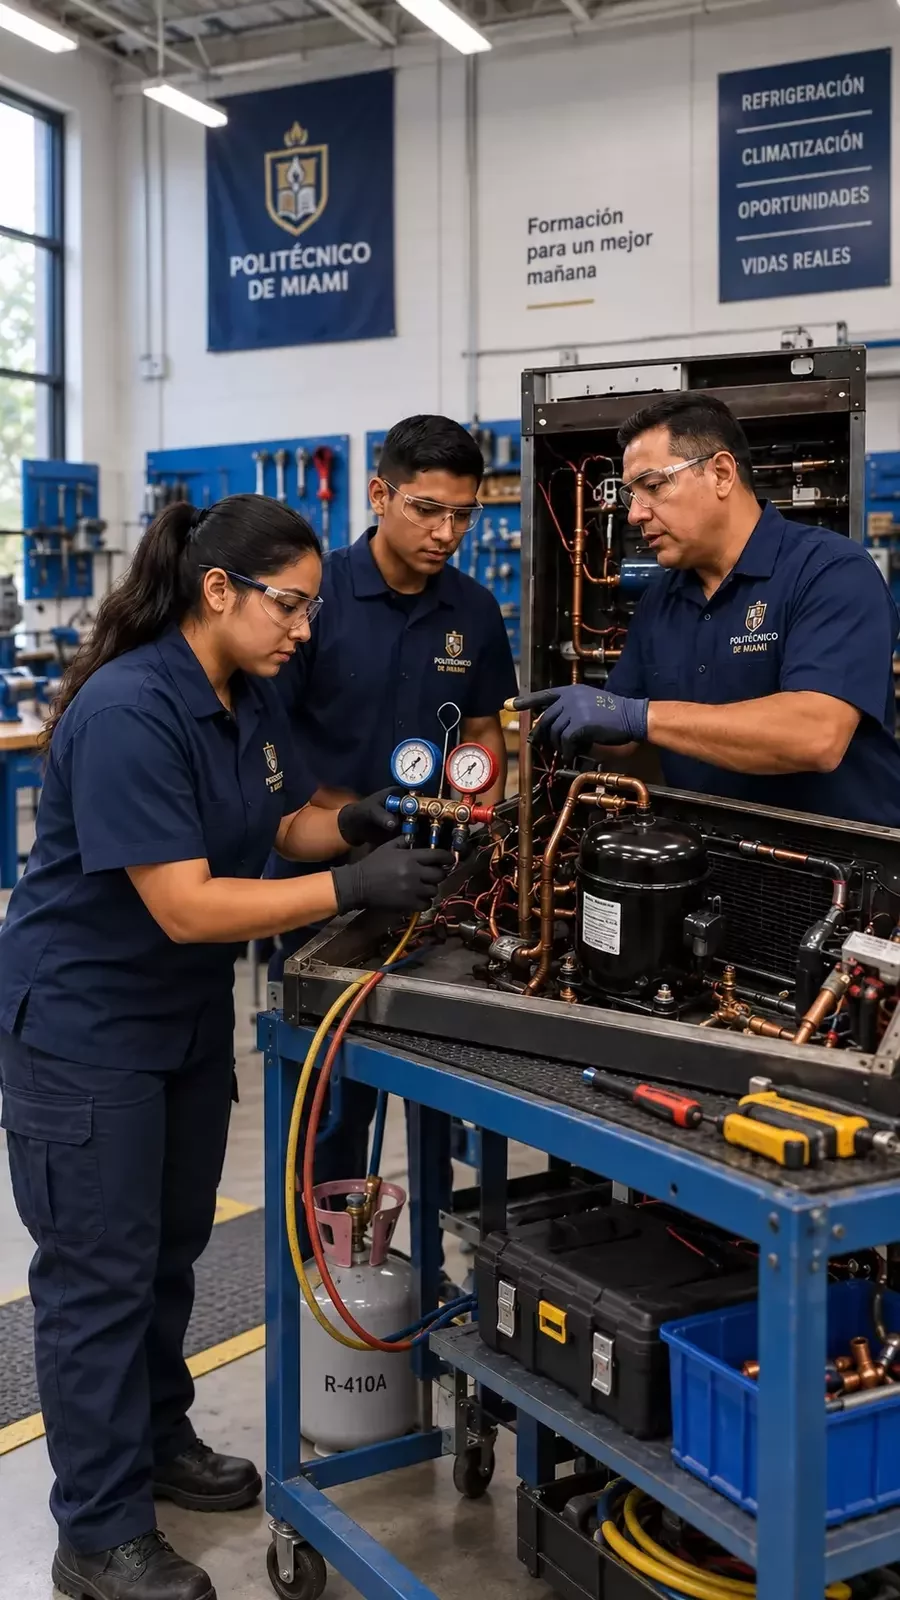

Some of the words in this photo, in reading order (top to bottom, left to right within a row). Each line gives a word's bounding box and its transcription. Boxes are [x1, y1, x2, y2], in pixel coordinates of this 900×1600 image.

[742, 73, 865, 112] REFRIGERACIÓN
[742, 129, 864, 166] CLIMATIZACIÓN
[738, 185, 870, 220] OPORTUNIDADES
[527, 207, 624, 235] Formación
[230, 242, 371, 277] POLITÉCNICO
[527, 242, 566, 265] para
[572, 239, 595, 255] un
[600, 230, 653, 253] mejor
[742, 253, 788, 275] VIDAS
[793, 246, 851, 271] REALES
[248, 278, 275, 301] DE
[281, 270, 348, 297] MIAMI
[527, 264, 597, 285] mañana
[730, 632, 778, 645] POLITÉCNICO
[733, 645, 741, 654] DE
[743, 643, 767, 652] MIAMI
[324, 1373, 387, 1393] R-410A
